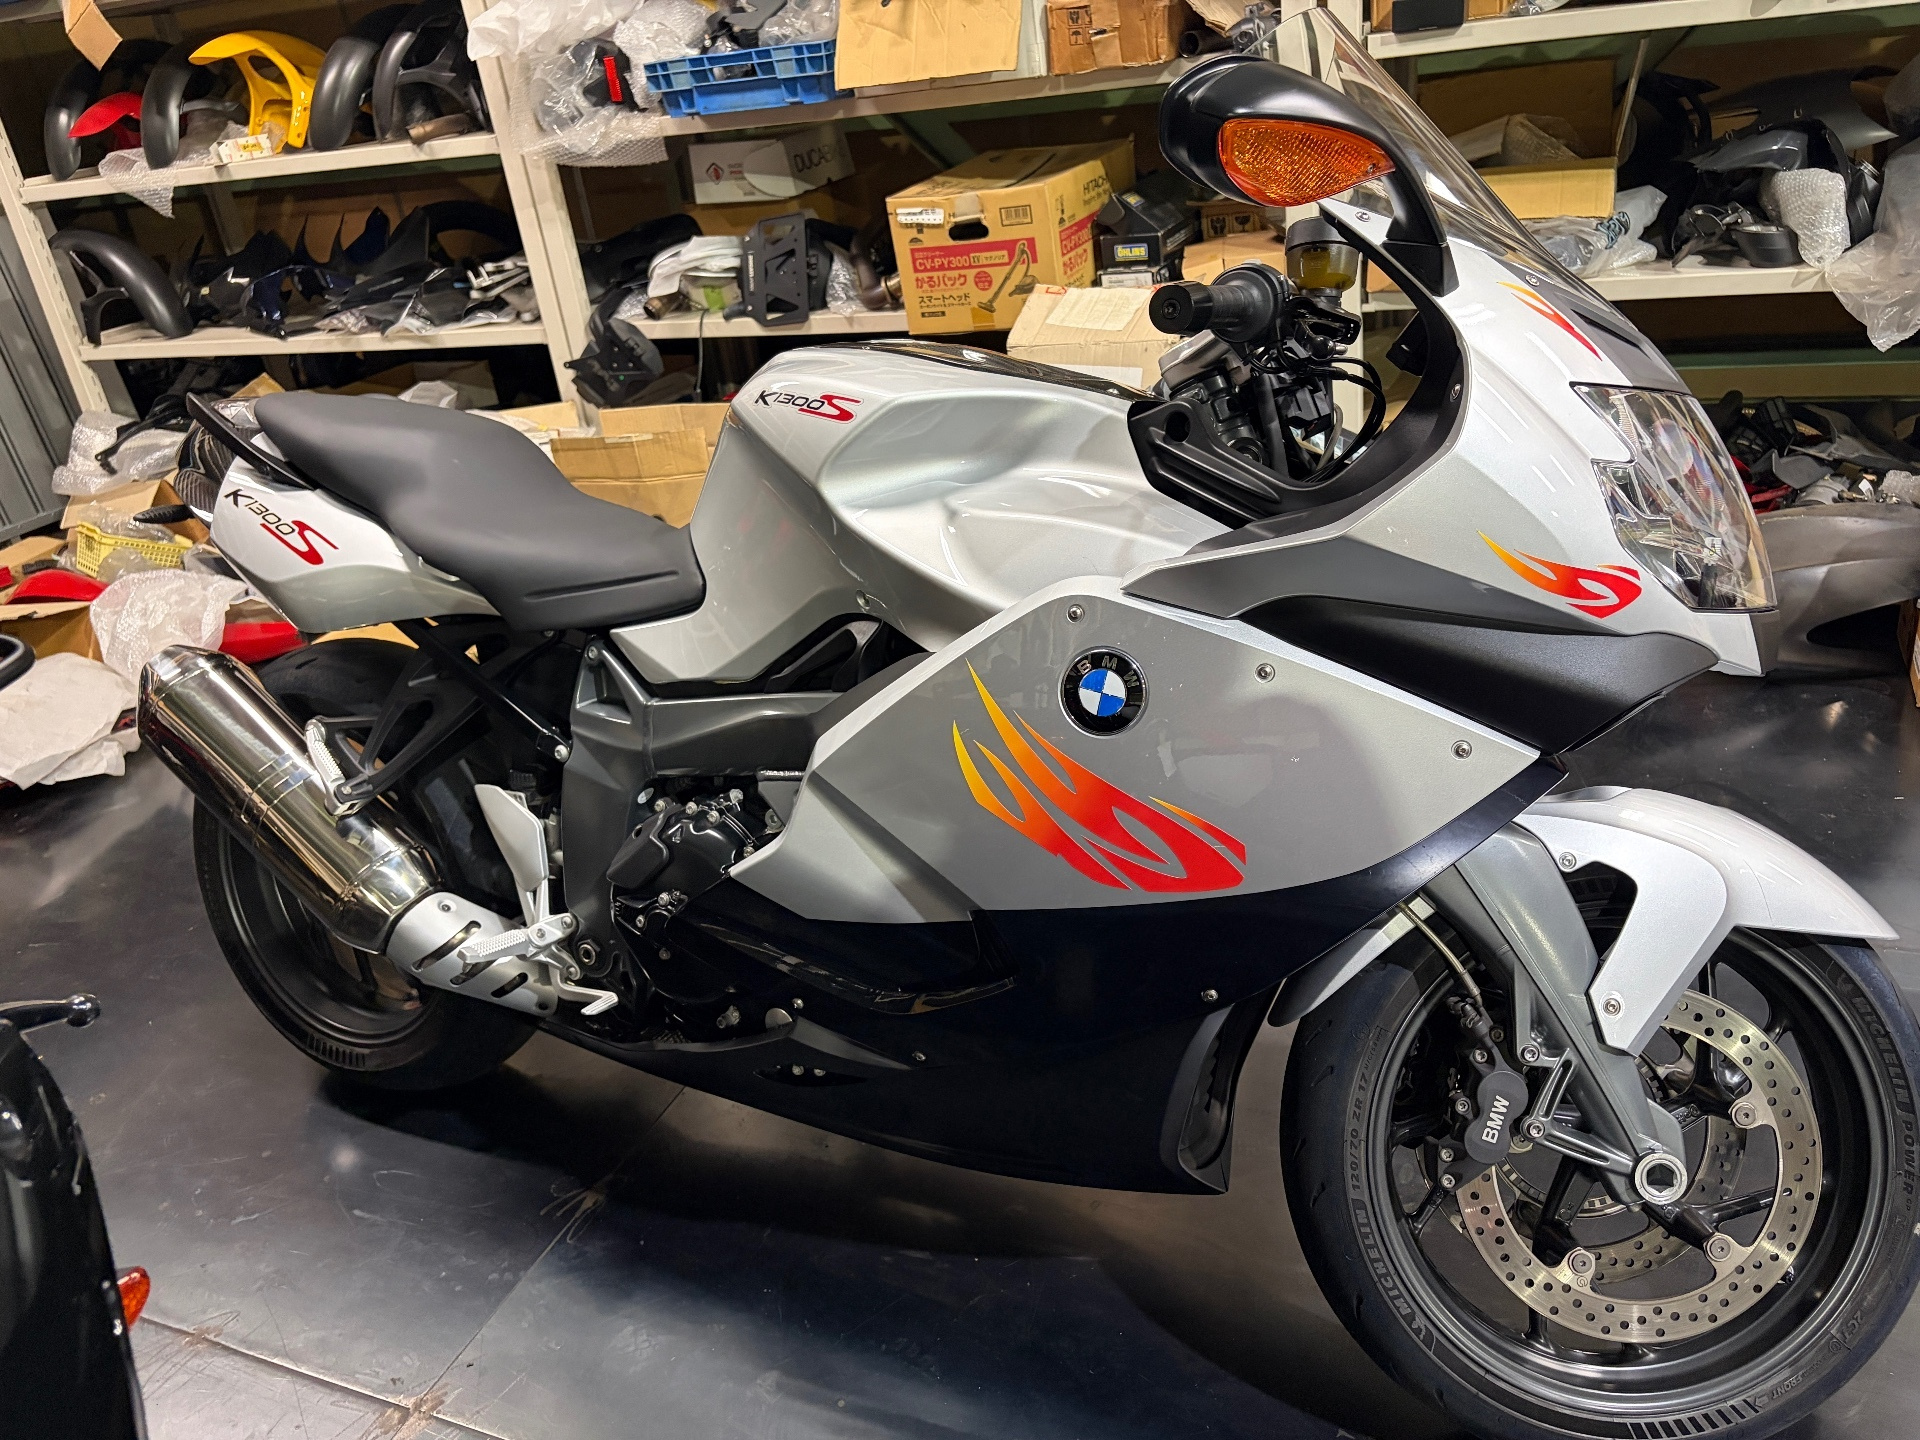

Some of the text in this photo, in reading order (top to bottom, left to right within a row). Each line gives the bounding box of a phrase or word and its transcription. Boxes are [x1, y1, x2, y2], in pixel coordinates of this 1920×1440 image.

[916, 256, 970, 270] CV-PY300
[915, 273, 967, 289] かるパック
[918, 293, 970, 304] スマートヘッド
[754, 389, 862, 422] K1300S
[223, 488, 340, 566] K1300S
[1076, 655, 1140, 688] BMW
[1357, 1072, 1368, 1092] 17
[1851, 996, 1910, 1104] MICHELIN
[1902, 1120, 1916, 1195] POWER
[1481, 1095, 1510, 1144] BMW
[1349, 1128, 1361, 1192] 120/70
[1355, 1209, 1412, 1316] MICHELIN
